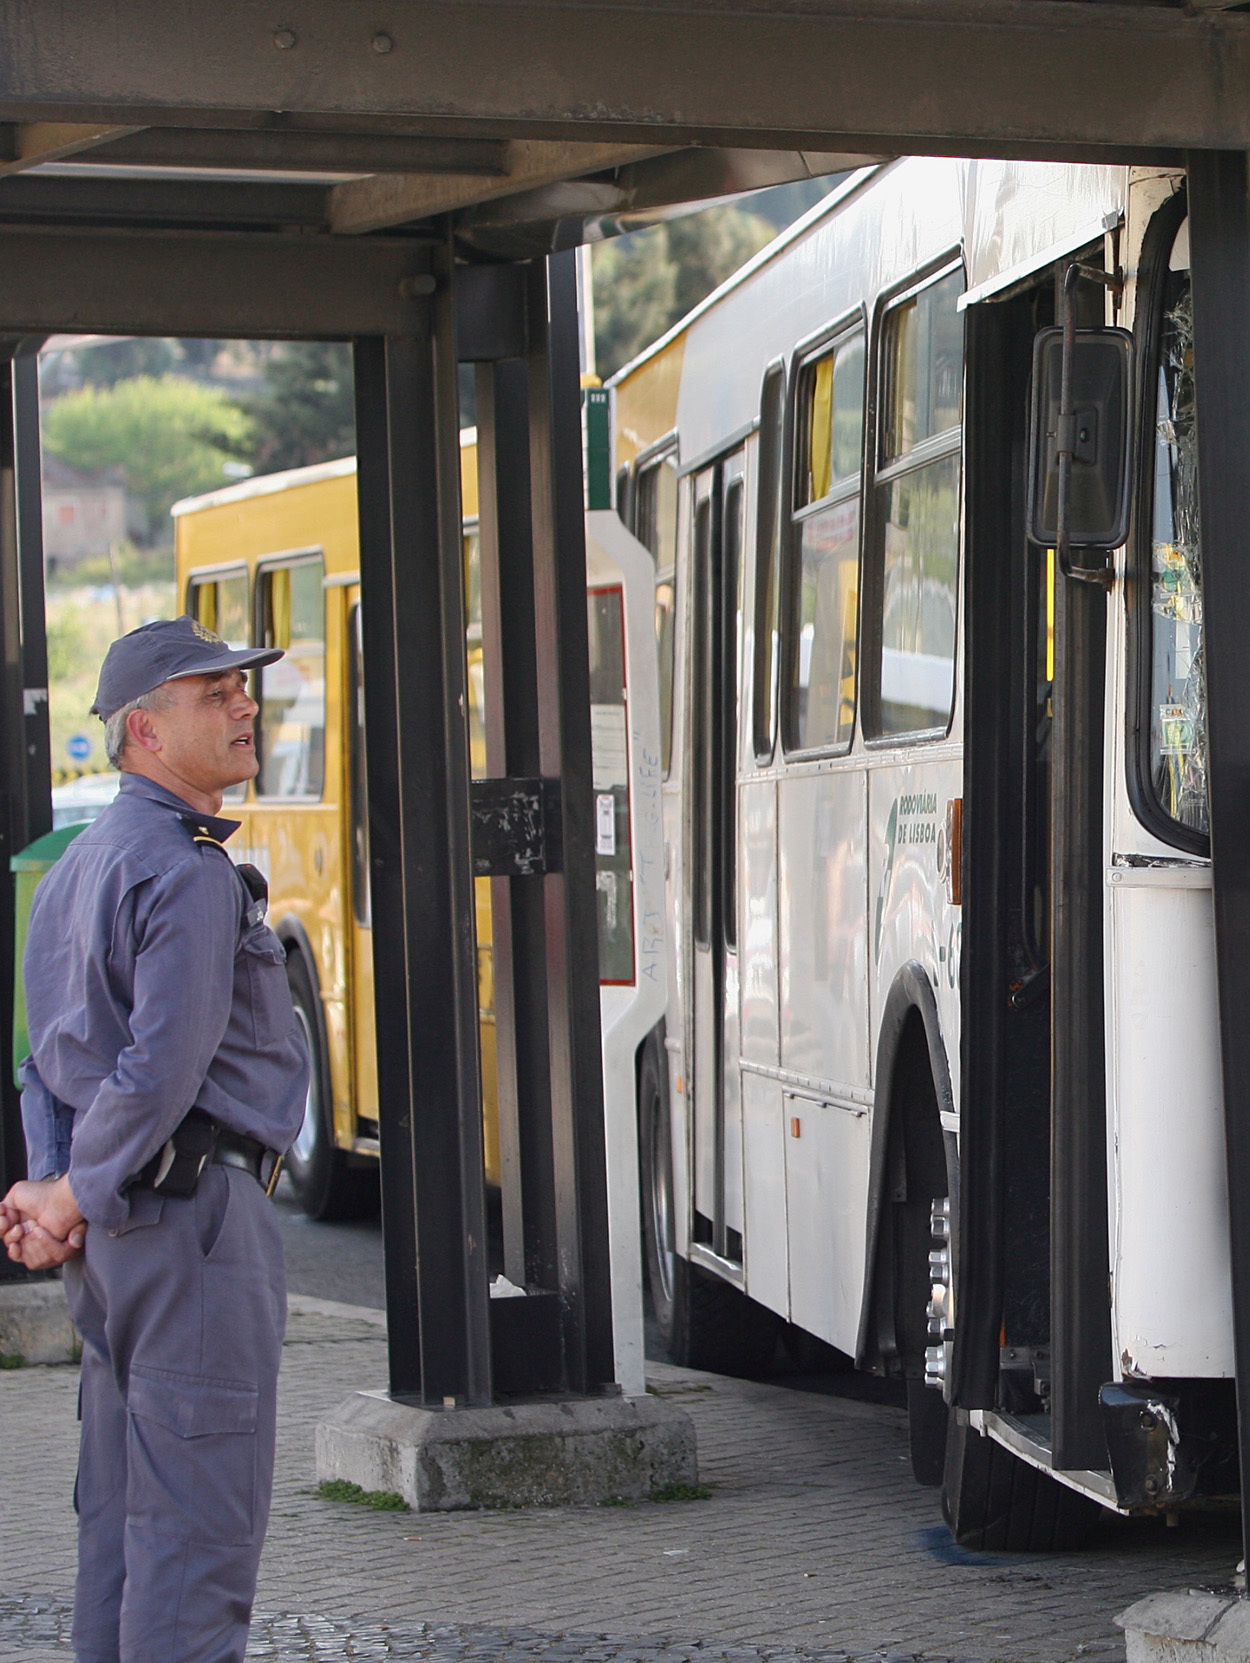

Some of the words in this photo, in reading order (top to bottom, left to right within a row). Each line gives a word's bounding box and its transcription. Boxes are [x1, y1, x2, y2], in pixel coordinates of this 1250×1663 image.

[899, 788, 937, 815] RODOVIÁRIA
[898, 823, 907, 844] DE
[908, 822, 936, 843] LISBOA
